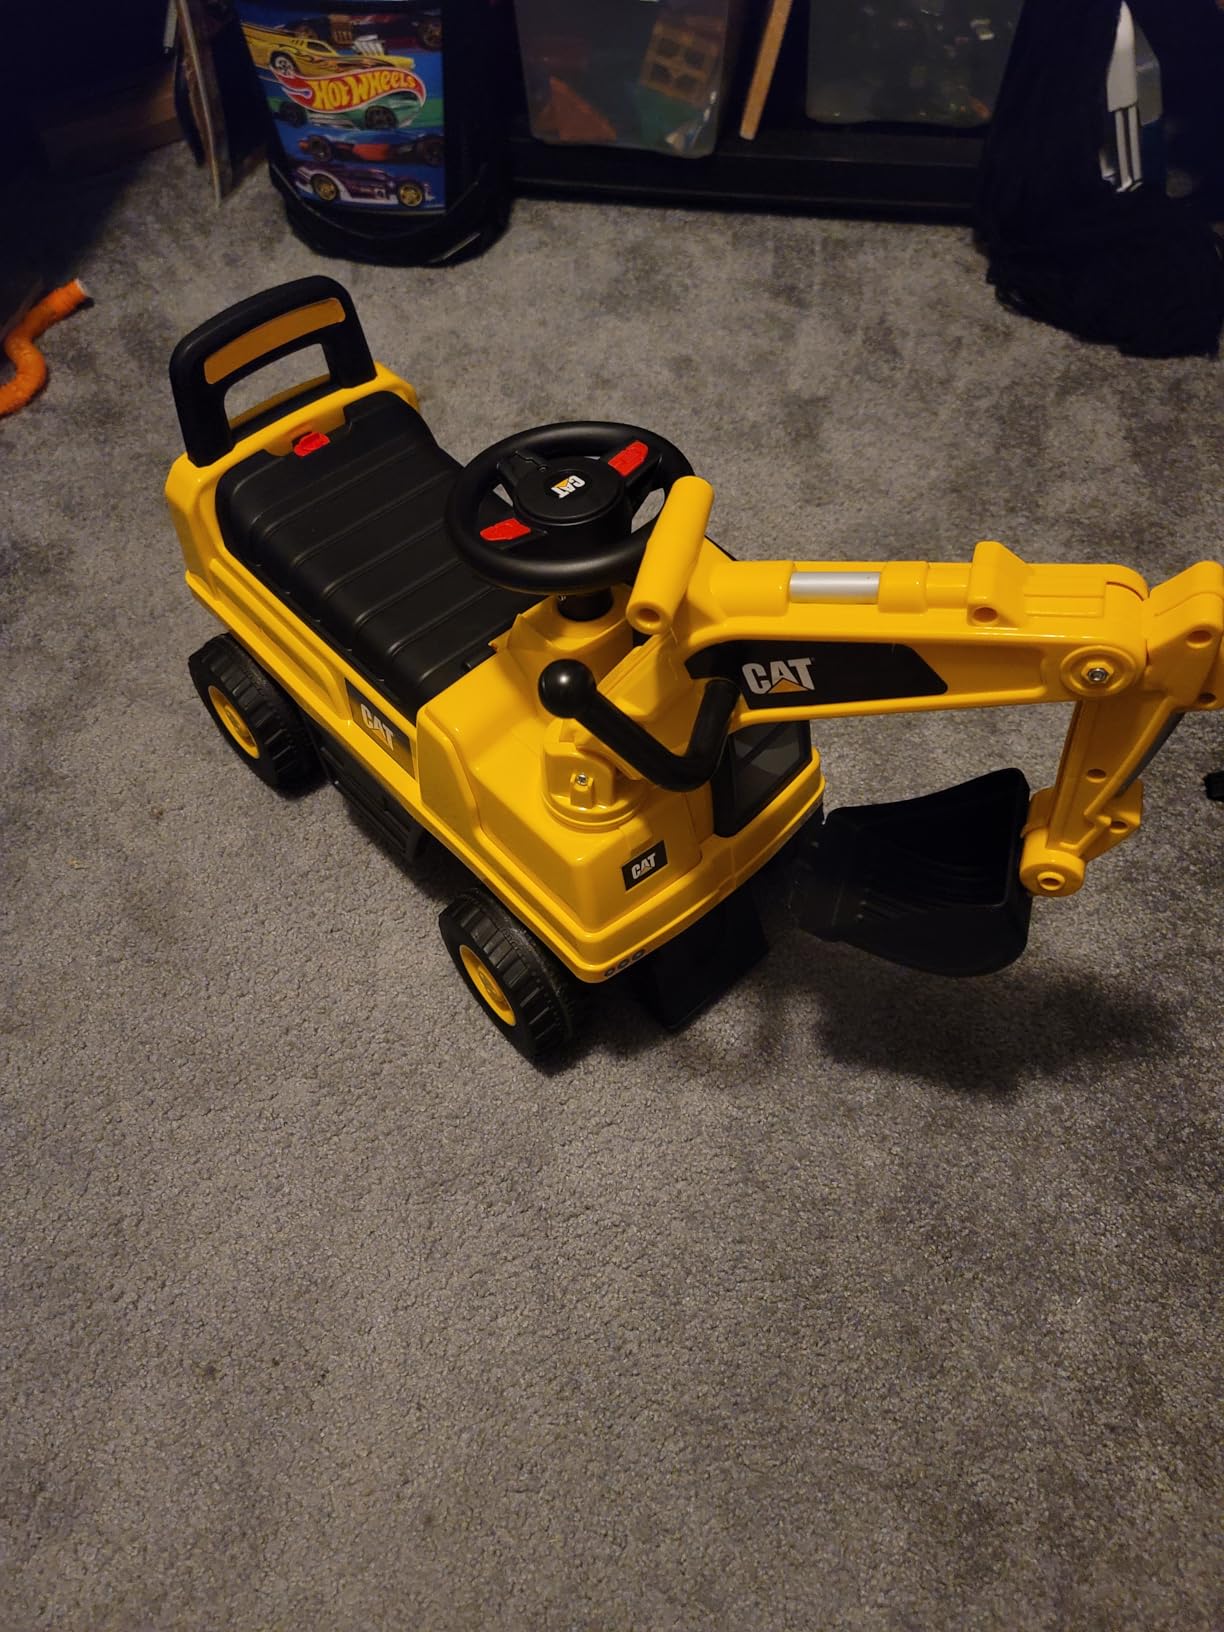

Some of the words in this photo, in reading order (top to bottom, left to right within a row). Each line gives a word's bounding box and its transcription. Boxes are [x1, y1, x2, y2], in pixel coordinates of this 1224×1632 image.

[310, 79, 350, 110] HOT
[551, 475, 585, 498] CAT
[742, 657, 815, 694] CAT
[360, 703, 394, 751] CAT
[631, 853, 656, 879] CAT
